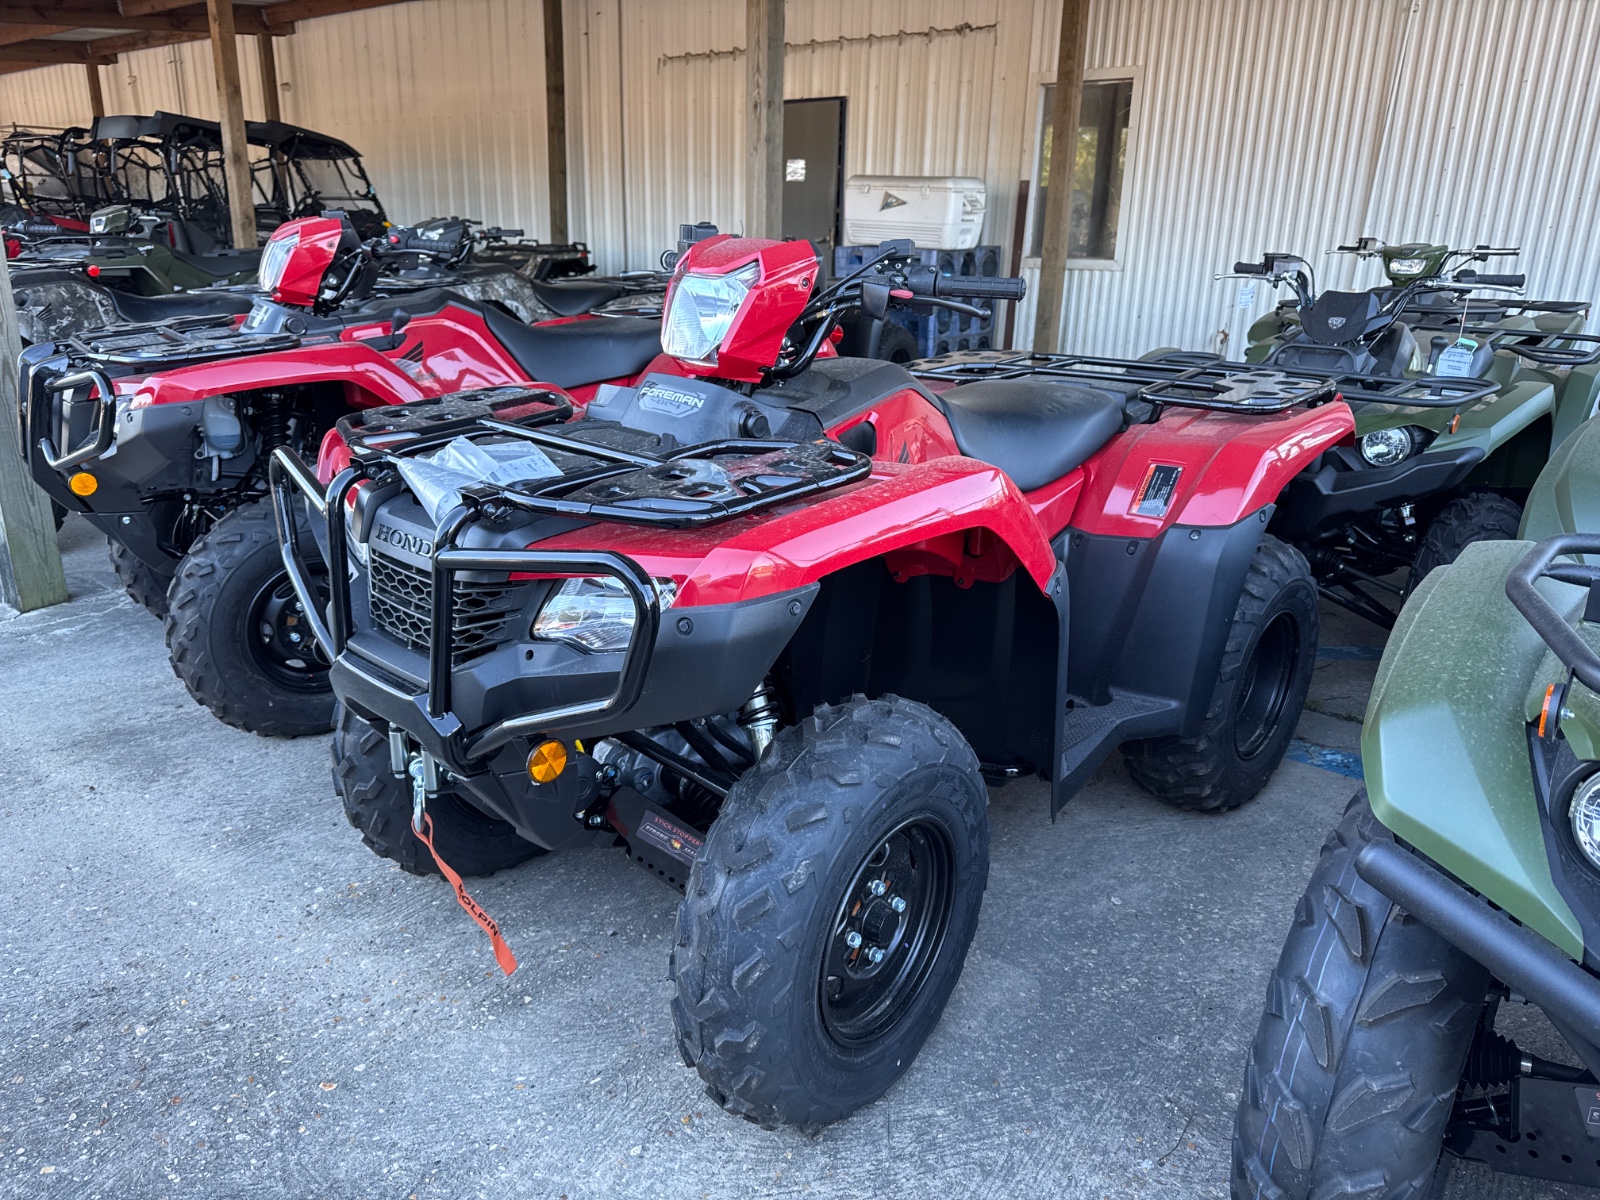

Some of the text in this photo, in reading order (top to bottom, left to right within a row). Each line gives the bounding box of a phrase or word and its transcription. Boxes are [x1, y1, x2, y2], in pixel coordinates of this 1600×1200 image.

[640, 387, 704, 408] FOREMAN
[375, 523, 433, 559] HOND
[655, 817, 672, 831] STICK
[458, 883, 498, 937] KOLPIN
